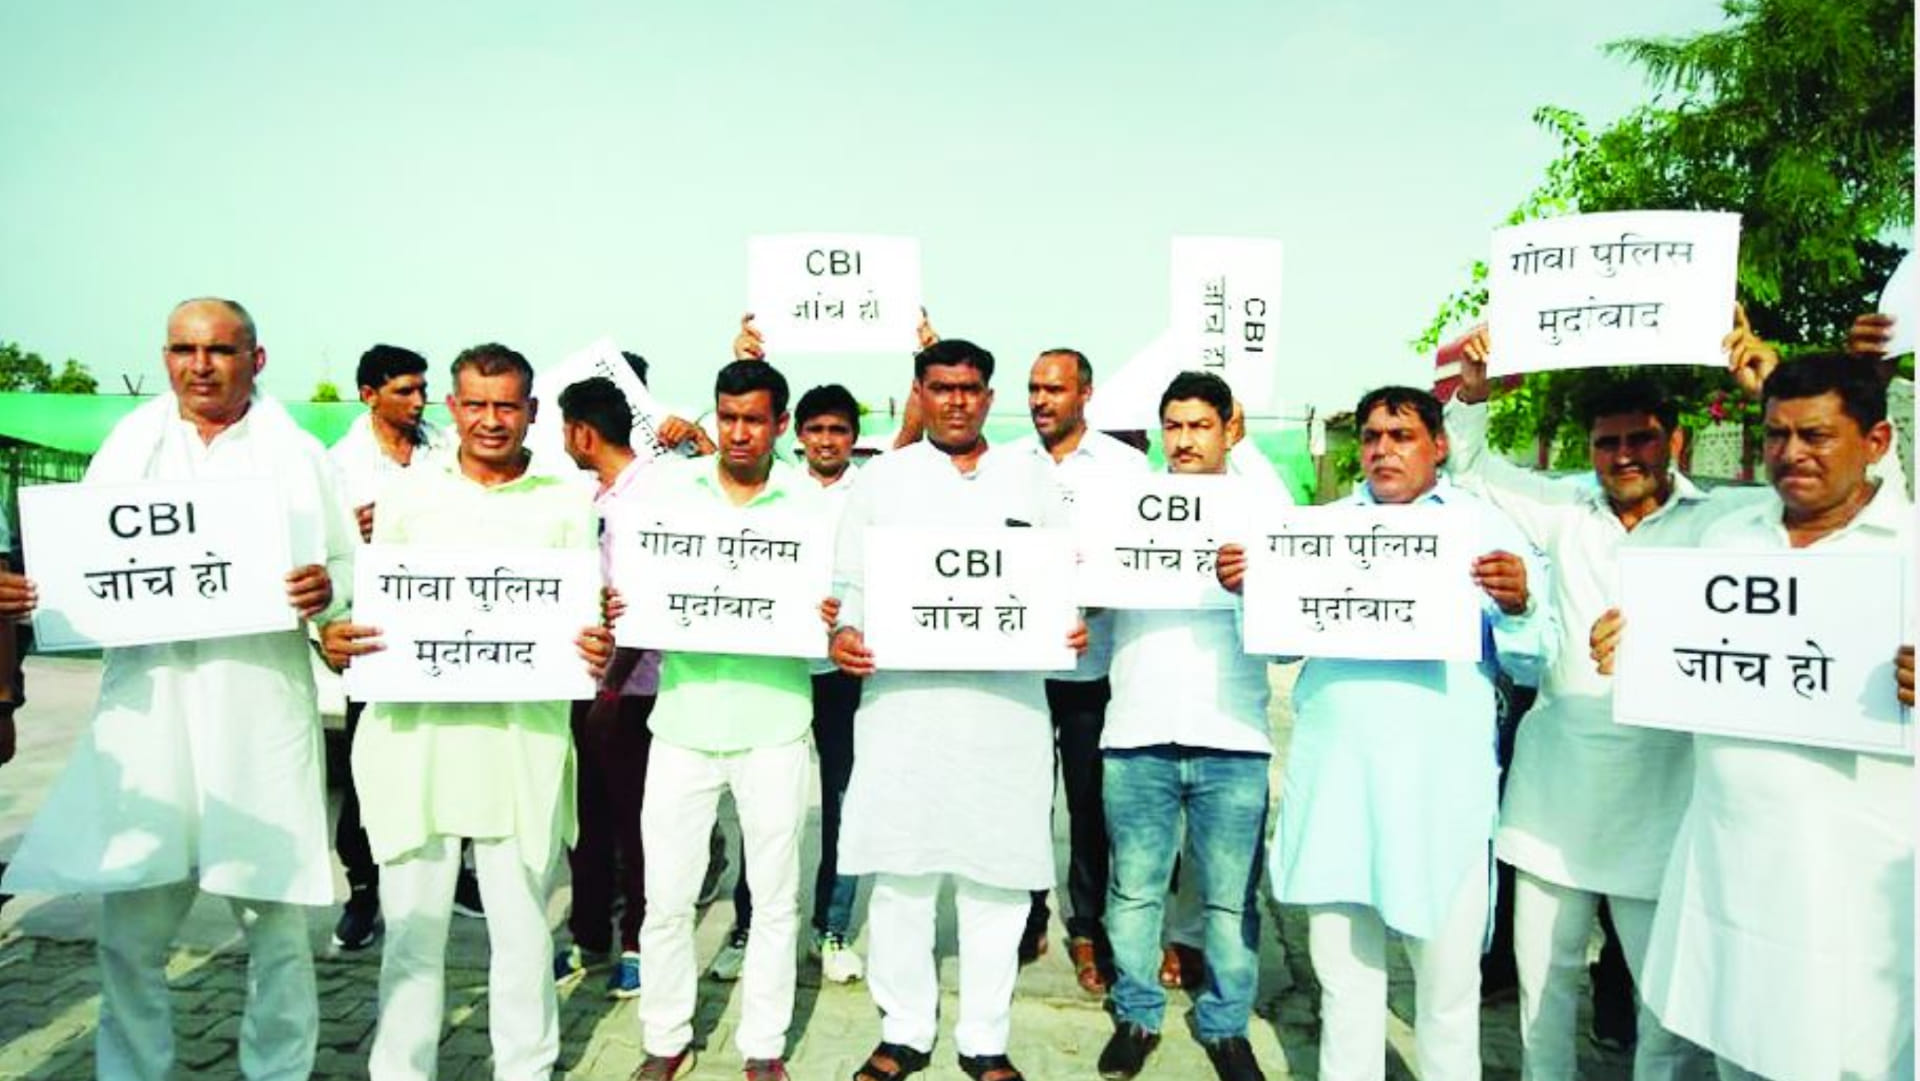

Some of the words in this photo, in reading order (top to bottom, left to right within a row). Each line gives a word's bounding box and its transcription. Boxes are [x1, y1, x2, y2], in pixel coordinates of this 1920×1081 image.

[806, 250, 861, 276] CBI
[1511, 243, 1577, 274] गोवा
[1590, 233, 1694, 277] पुलिस
[1244, 298, 1266, 352] CBI
[1539, 296, 1663, 346] मुर्दाबाद
[108, 501, 196, 539] CBI
[1138, 494, 1201, 522] CBI
[639, 522, 706, 557] गोवा
[717, 528, 801, 570] पुलिस
[935, 549, 1002, 578] CBI
[1115, 539, 1182, 570] जांच
[1267, 524, 1334, 557] गोवा
[1344, 524, 1438, 570] पुलिस
[84, 558, 176, 602] जांच
[190, 551, 232, 599] हो
[379, 564, 456, 602] गोवा
[465, 566, 562, 612] पुलिस
[1705, 574, 1797, 616] CBI
[667, 585, 776, 627] मुर्दाबाद
[912, 596, 983, 630] जांच
[994, 594, 1027, 632] हो
[1299, 588, 1416, 632] मुर्दाबाद
[414, 629, 536, 677] मुर्दाबाद
[1673, 638, 1768, 688] जांच
[1786, 639, 1835, 700] हो
